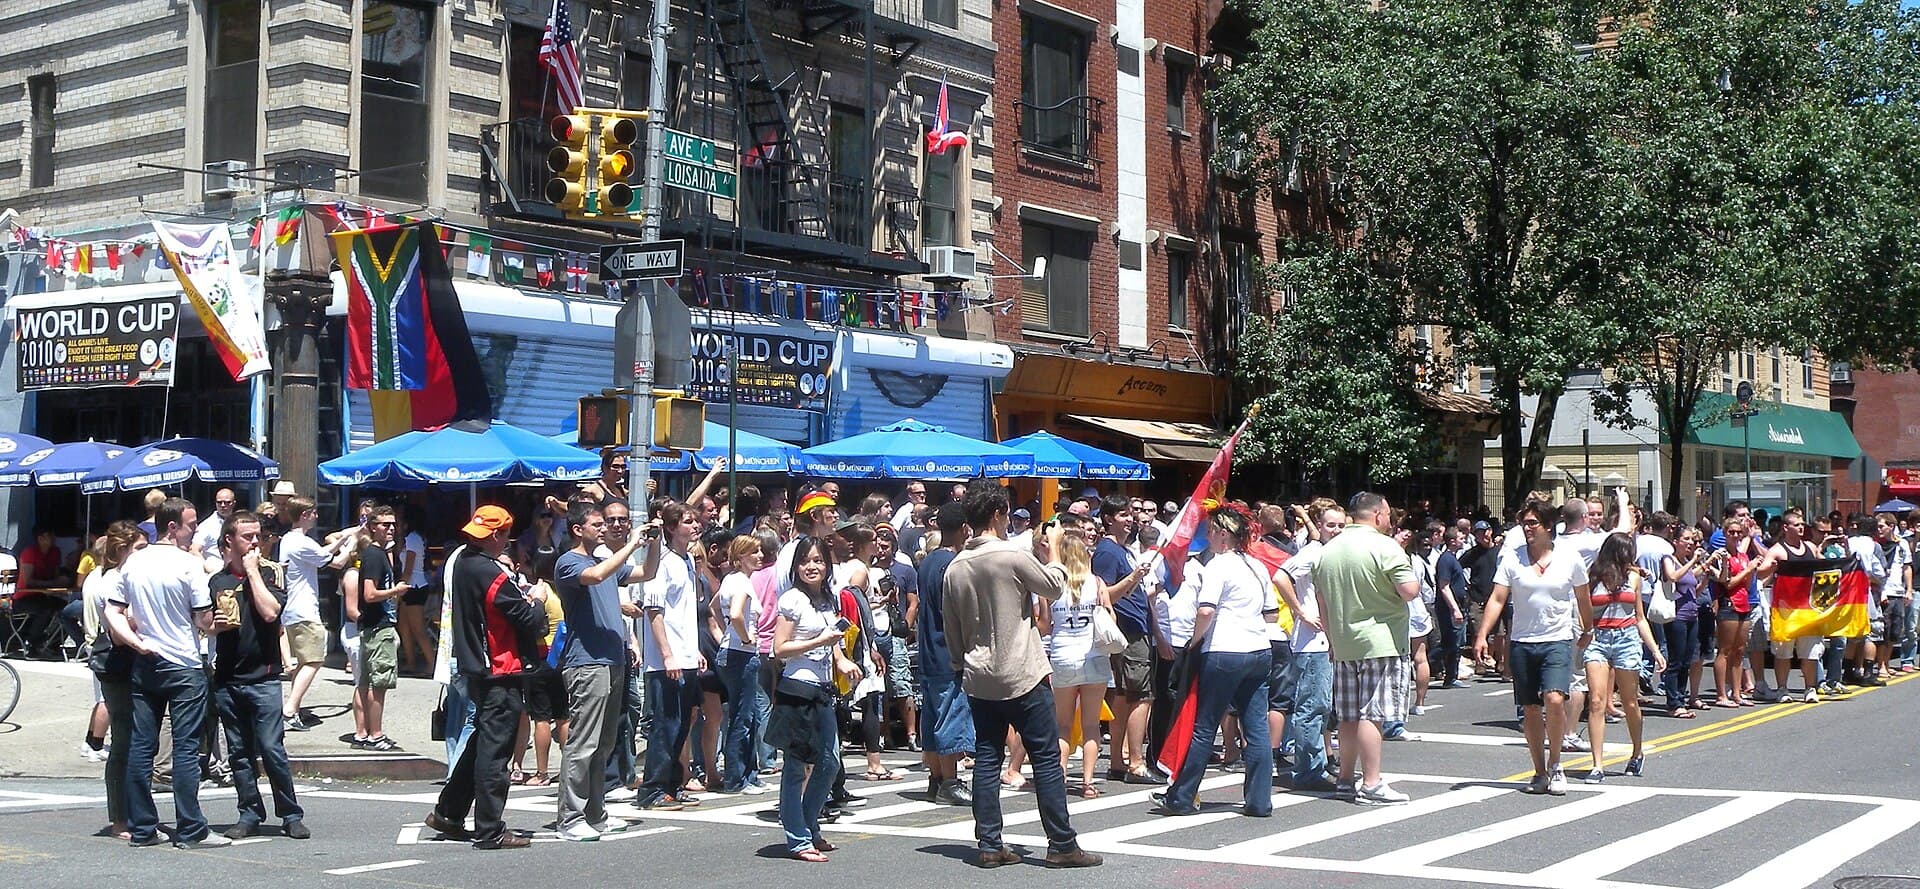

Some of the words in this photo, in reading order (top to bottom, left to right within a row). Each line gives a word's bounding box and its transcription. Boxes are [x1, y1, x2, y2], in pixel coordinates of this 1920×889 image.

[669, 134, 693, 158] AVE
[700, 142, 708, 162] C
[668, 161, 717, 192] LOISAIDA
[612, 254, 635, 270] ONE
[646, 251, 672, 268] WAY
[19, 308, 109, 340] WORLD
[117, 302, 175, 334] CUP
[68, 339, 78, 348] ALL
[78, 338, 97, 347] GAMES
[97, 337, 109, 345] LIVE
[105, 344, 122, 353] GREAT
[122, 343, 139, 352] FOOD
[21, 339, 53, 368] 2010
[72, 354, 90, 363] FRESH
[105, 352, 121, 361] RIGHT
[121, 351, 137, 360] HERE
[778, 340, 829, 367] CUP
[744, 455, 780, 465] MÜNCHEN
[806, 463, 837, 472] HOFBRÄU
[845, 463, 875, 473] MÜNCHEN
[892, 463, 925, 473] HOFBRÄU
[936, 463, 973, 473] MÜNCHEN
[1037, 466, 1072, 474] MÜNCHEN
